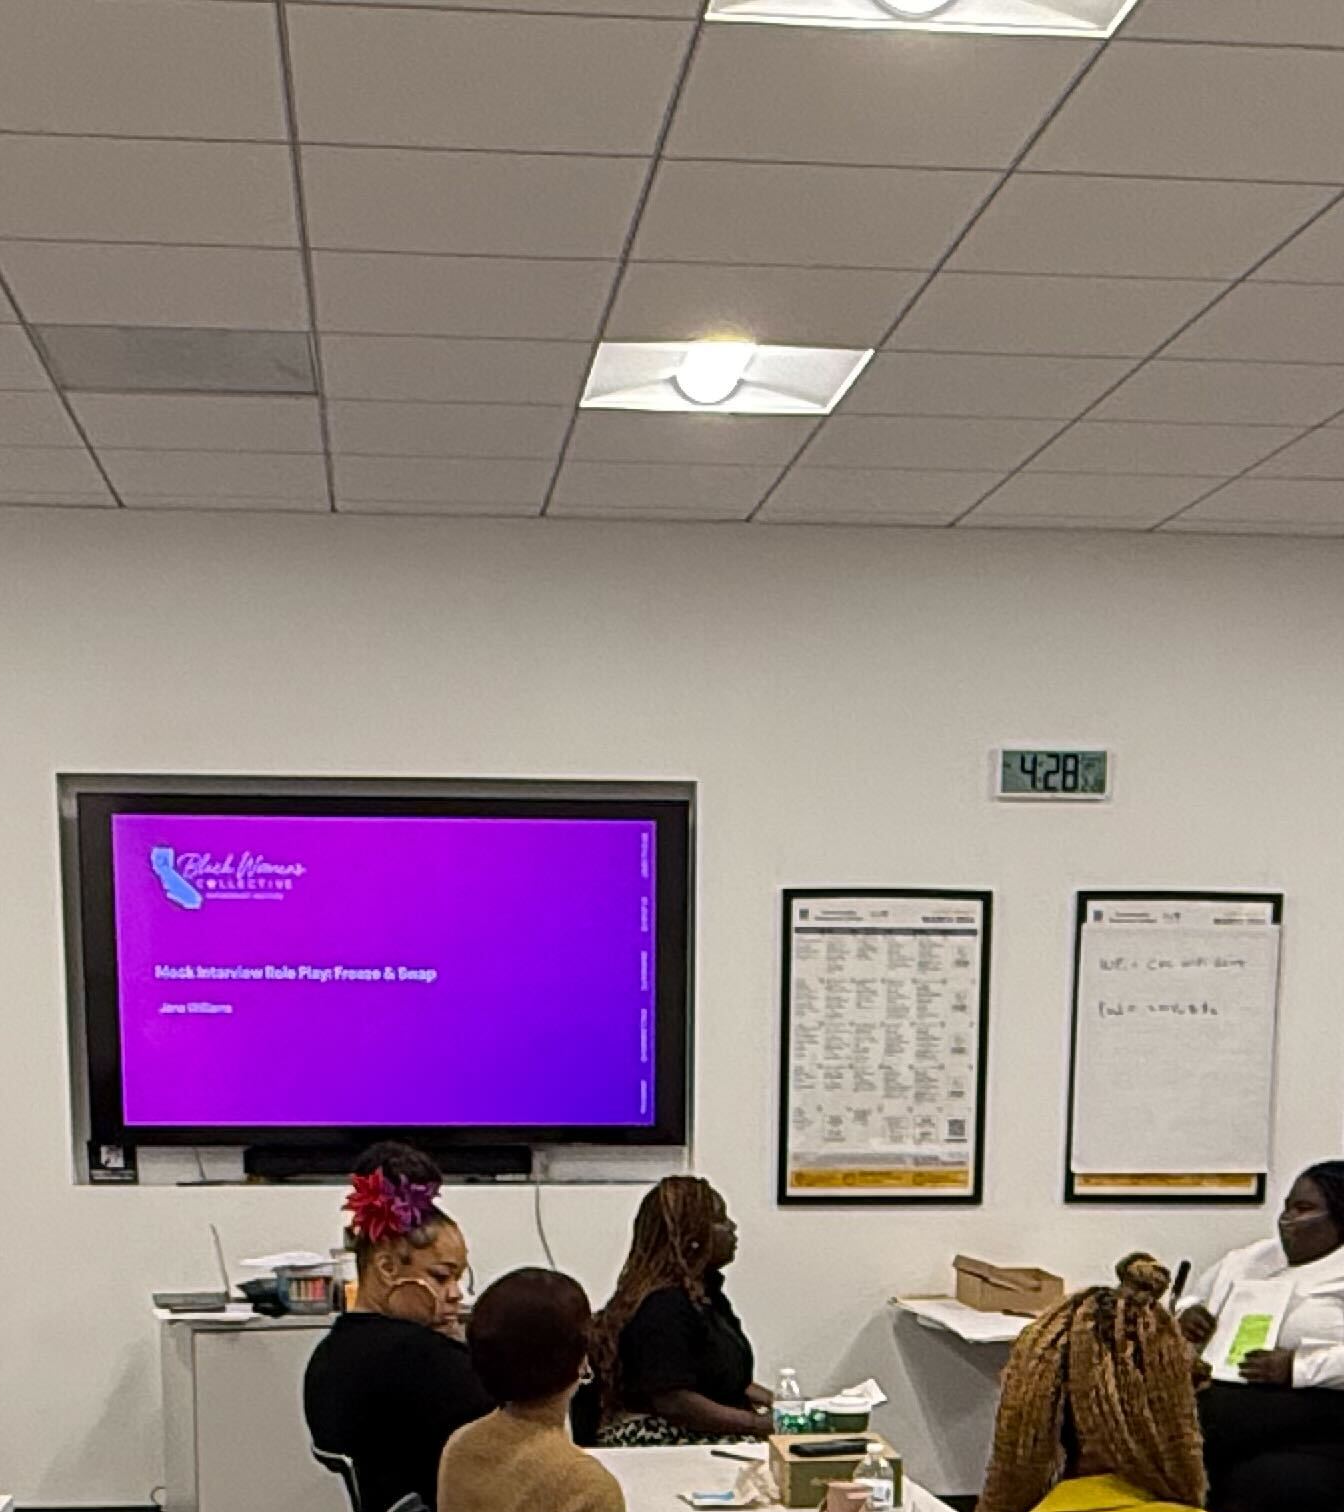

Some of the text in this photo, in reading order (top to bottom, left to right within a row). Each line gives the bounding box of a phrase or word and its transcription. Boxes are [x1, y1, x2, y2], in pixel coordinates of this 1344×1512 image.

[1020, 752, 1079, 791] 4:28
[196, 965, 264, 980] Interview
[382, 967, 396, 981] &
